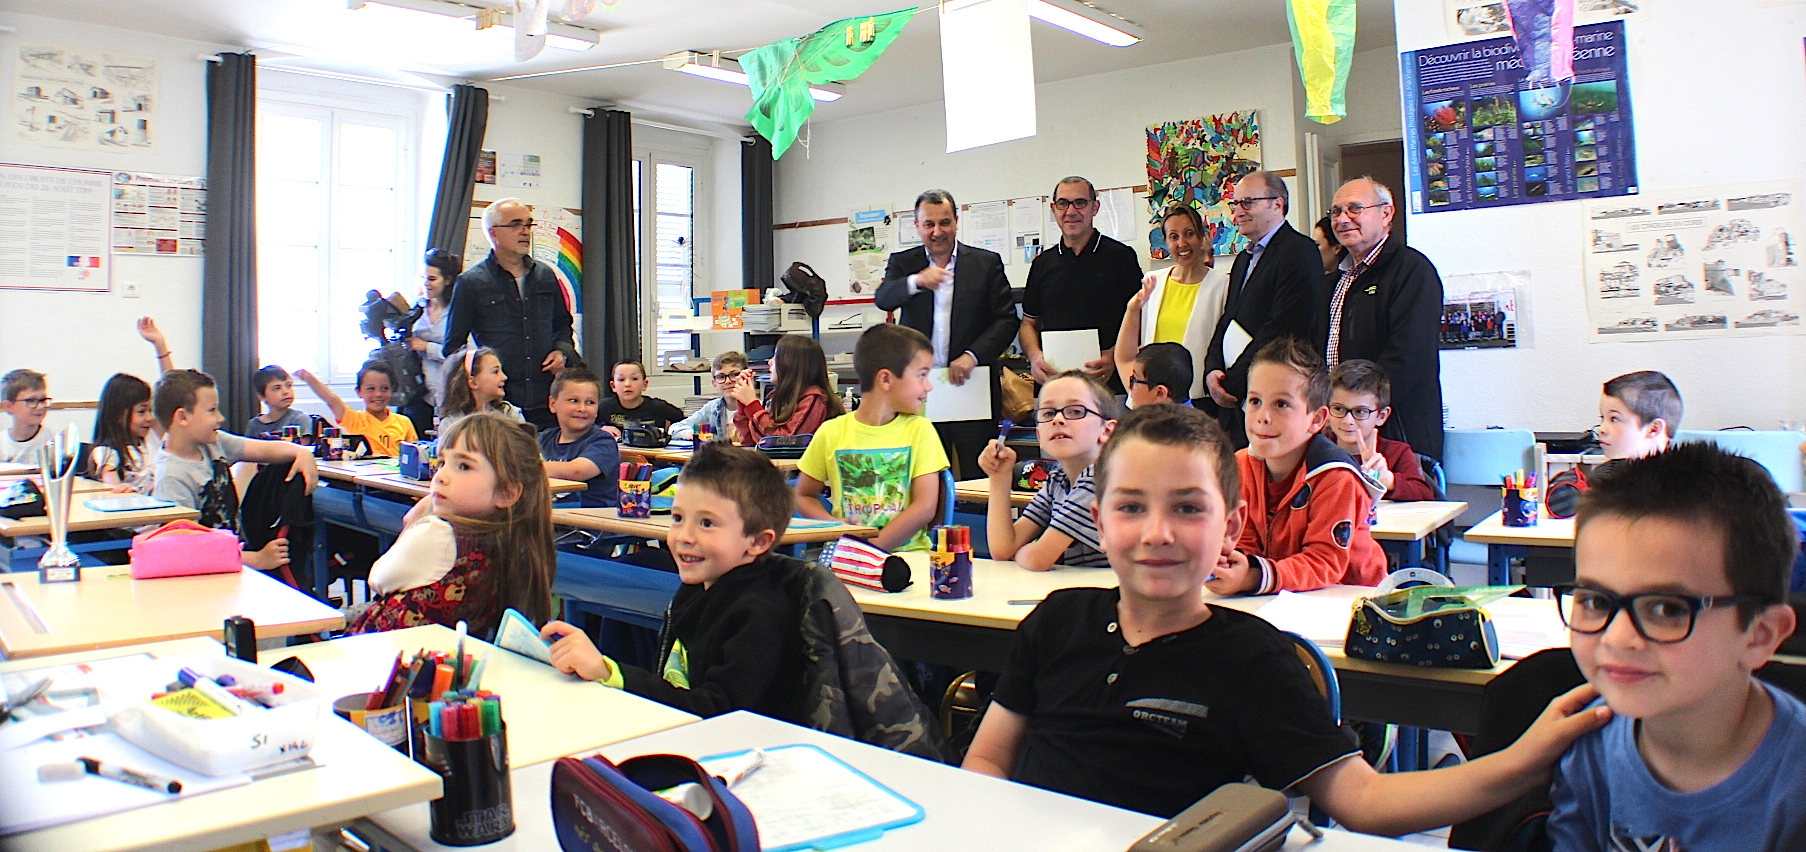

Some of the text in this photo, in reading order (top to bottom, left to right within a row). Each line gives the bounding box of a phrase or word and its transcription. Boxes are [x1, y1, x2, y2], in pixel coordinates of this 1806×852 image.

[1419, 29, 1614, 67] Découvrir la biodiv -marine
[1407, 99, 1416, 128] Protégées
[1409, 127, 1417, 150] Marines
[1410, 150, 1418, 165] Aires
[1411, 166, 1419, 177] Les
[378, 435, 390, 449] 10
[846, 502, 905, 515] TROPCAL
[456, 803, 511, 825] STAR
[456, 817, 511, 839] WARS
